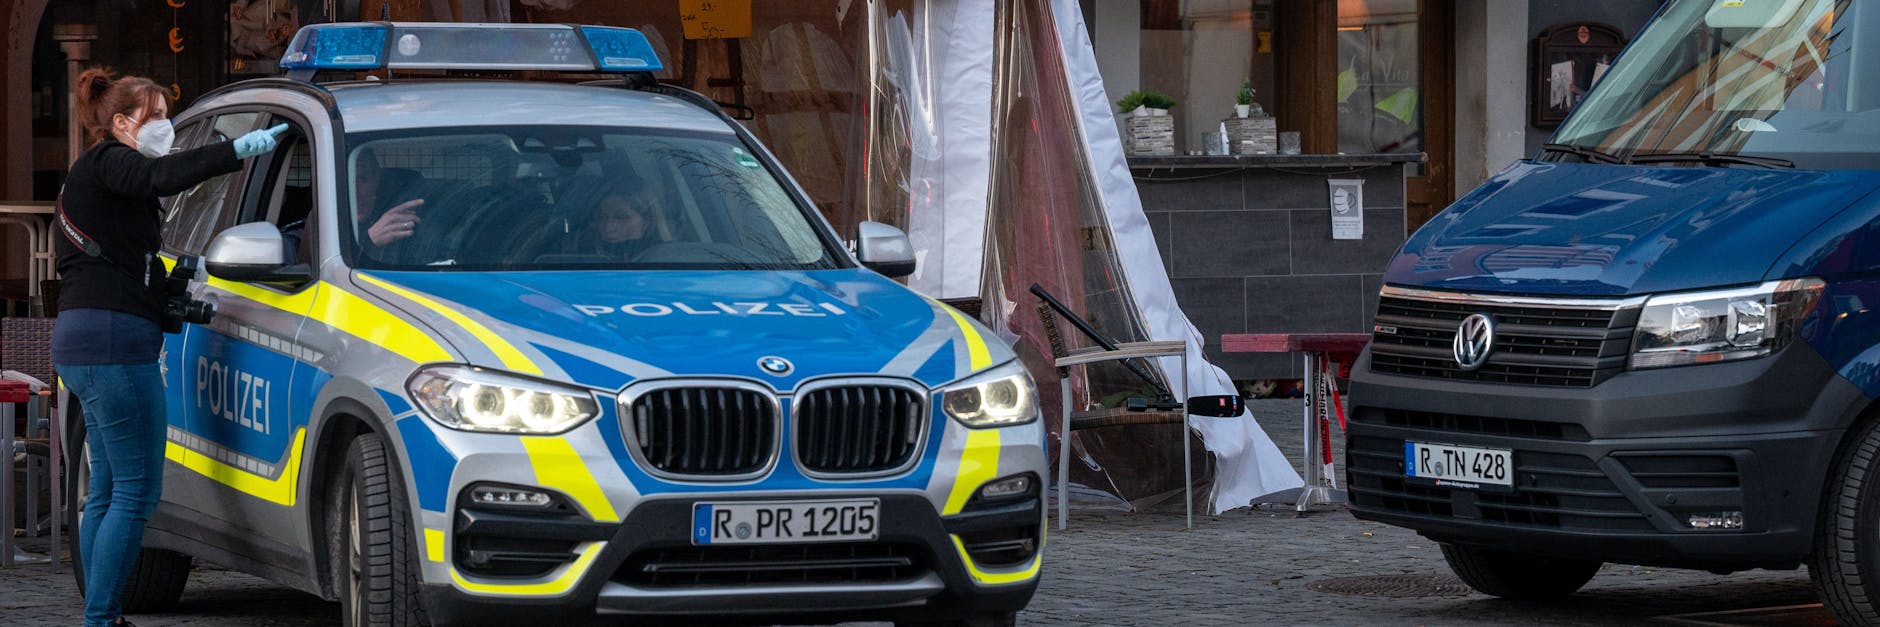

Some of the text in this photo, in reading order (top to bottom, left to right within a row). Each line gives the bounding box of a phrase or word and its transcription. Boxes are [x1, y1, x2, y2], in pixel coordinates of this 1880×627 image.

[571, 302, 847, 317] POLIZEI
[197, 355, 271, 435] POLIZEI
[1305, 393, 1311, 407] 3
[1421, 447, 1506, 480] R TN 428
[713, 505, 876, 539] R PR 1205
